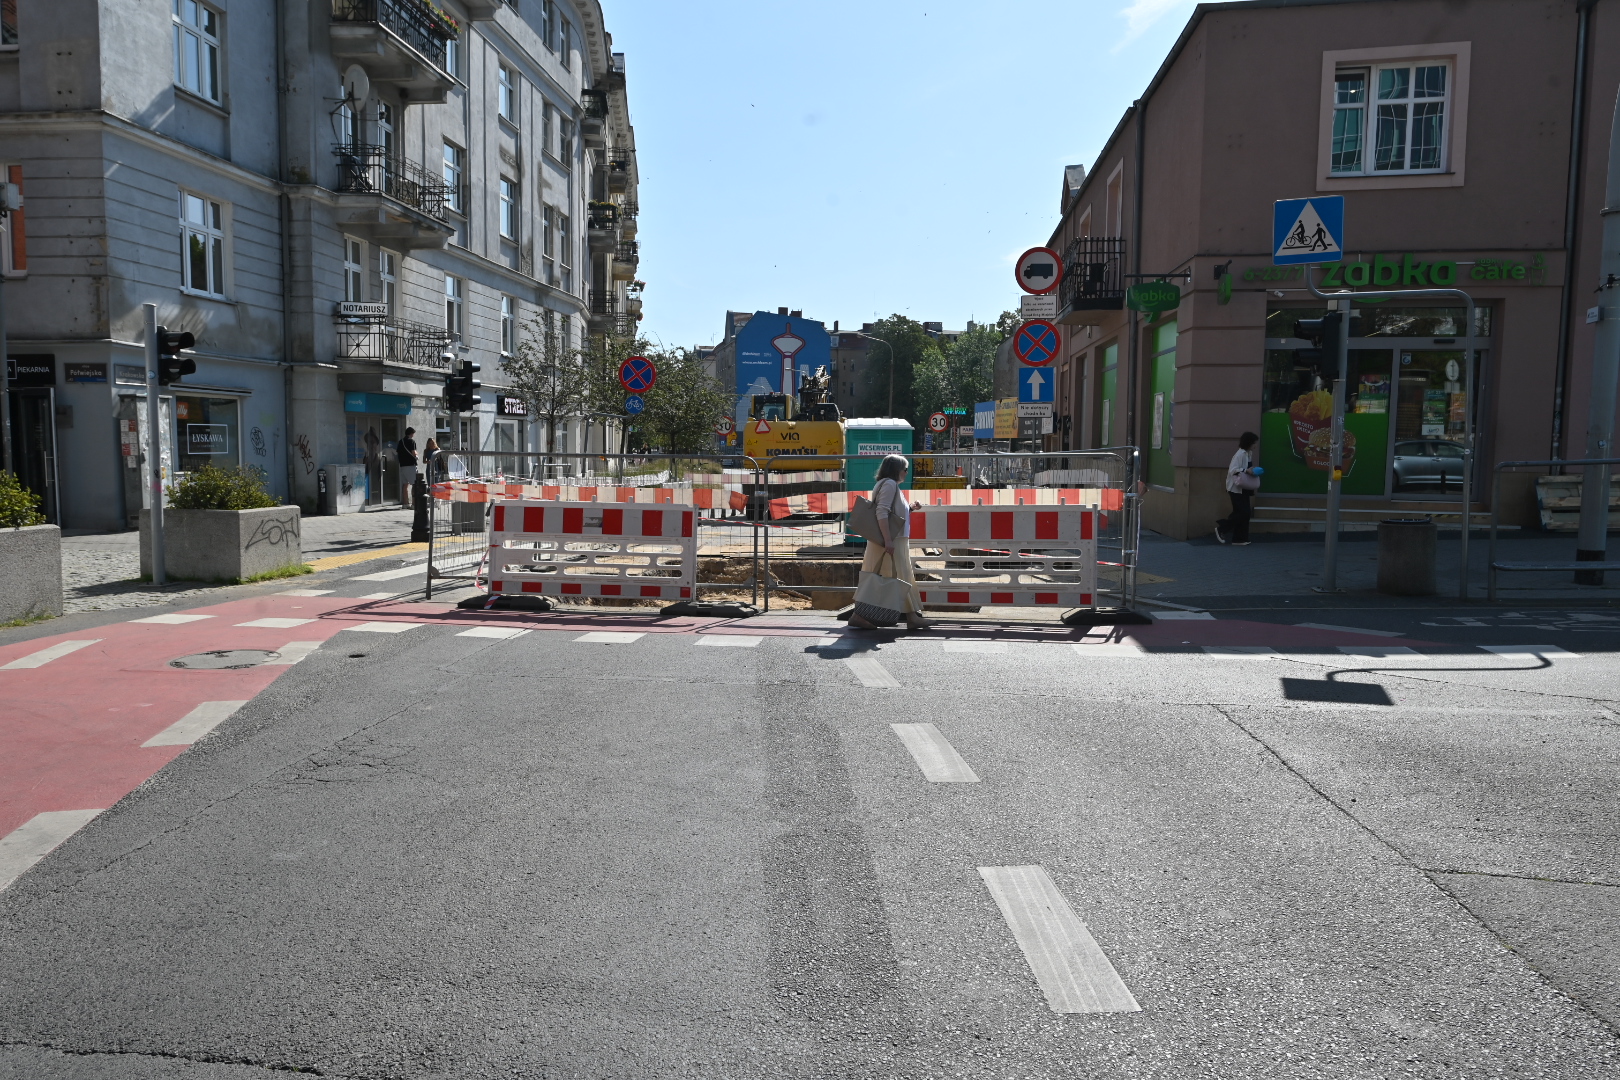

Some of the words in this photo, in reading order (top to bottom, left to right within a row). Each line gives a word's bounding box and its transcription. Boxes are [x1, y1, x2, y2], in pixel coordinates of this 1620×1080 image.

[1470, 259, 1527, 280] café
[343, 304, 386, 314] NOTARIUSZ
[17, 366, 50, 374] PIEKARNIA
[70, 369, 103, 377] Półwiejska
[932, 417, 945, 428] 30
[192, 433, 223, 443] ŁYSKAWA
[766, 446, 818, 456] KOMATSU
[859, 444, 902, 452] WCSERWIS.PL
